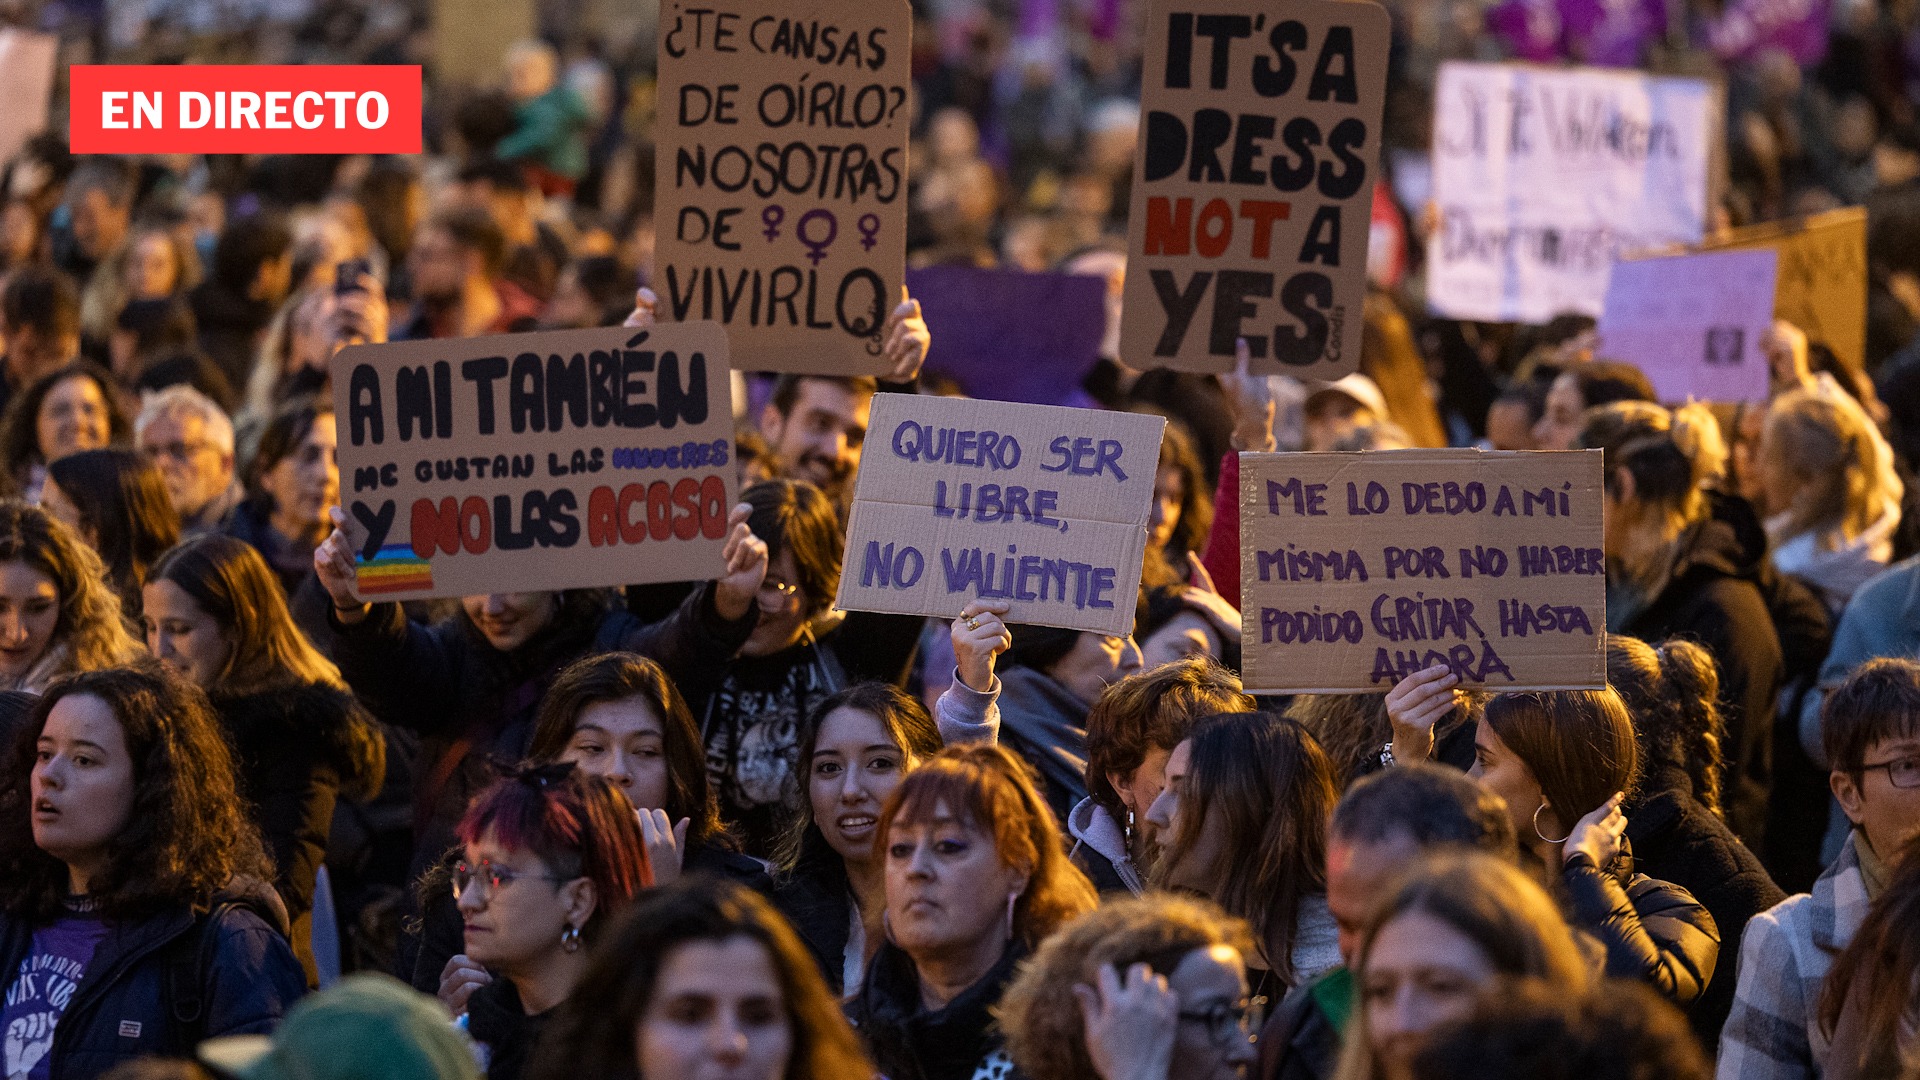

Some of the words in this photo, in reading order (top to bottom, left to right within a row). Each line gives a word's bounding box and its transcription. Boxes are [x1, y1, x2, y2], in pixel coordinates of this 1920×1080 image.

[665, 3, 740, 58] ¿TE
[750, 15, 887, 71] CANSAS
[1164, 12, 1308, 98] IT'S
[1306, 26, 1359, 104] A
[679, 83, 739, 127] DE
[758, 72, 906, 128] OÍRLO?
[676, 142, 900, 204] NOSOTRAS
[1144, 108, 1367, 200] DRESS
[677, 206, 743, 251] DE
[1144, 196, 1291, 260] NOT
[1297, 205, 1341, 267] A
[666, 264, 888, 338] VIVIRLO
[1150, 269, 1334, 367] YES
[349, 363, 384, 447] A
[396, 360, 452, 442] MI
[461, 330, 708, 436] TAMBIÉN
[353, 463, 398, 493] ME
[414, 453, 534, 484] GUSTAN
[548, 448, 605, 477] LAS
[891, 420, 1022, 471] QUIERO
[1040, 435, 1129, 482] SER
[351, 500, 396, 561] Y
[410, 495, 491, 560] NO
[493, 488, 580, 550] LAS
[587, 475, 728, 548] ACOSO
[933, 480, 1069, 533] LIBRE,
[1266, 477, 1328, 517] ME
[1347, 480, 1390, 516] LO
[1402, 481, 1486, 516] DEBO
[1492, 485, 1518, 517] A
[860, 540, 925, 590] NO
[1383, 545, 1450, 579] POR
[1460, 544, 1508, 578] NO
[1518, 545, 1605, 578] HABER
[1499, 598, 1593, 637] HASTA
[1370, 640, 1516, 686] AHORA
